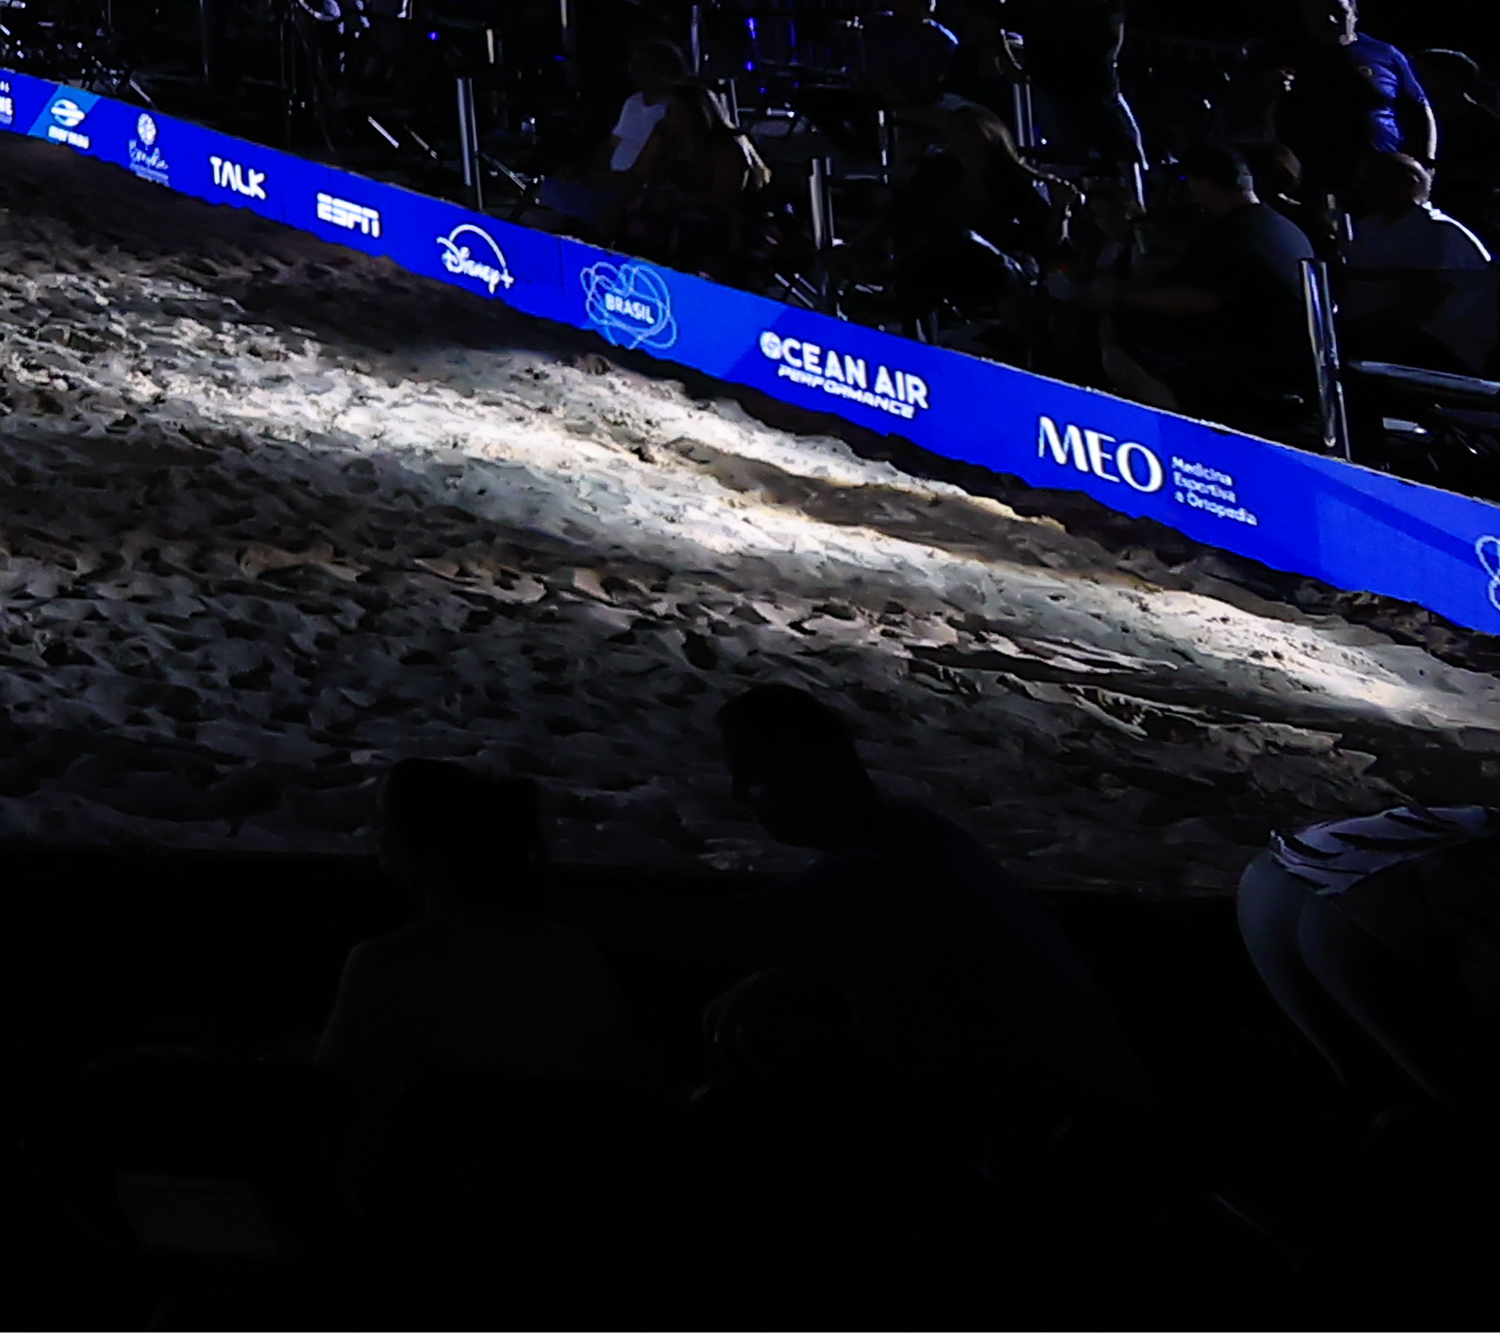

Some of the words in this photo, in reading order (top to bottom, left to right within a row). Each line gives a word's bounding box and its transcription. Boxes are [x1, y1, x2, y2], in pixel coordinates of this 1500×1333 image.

[210, 155, 266, 200] TALK
[316, 192, 381, 238] ESPN
[604, 293, 657, 325] BRASIL
[760, 331, 867, 389] OCEAN
[874, 365, 929, 410] AIR
[778, 364, 916, 420] PERFORMANCE
[1038, 415, 1164, 493] MEO
[1171, 456, 1233, 486] Medicina
[1173, 471, 1237, 504] Esportiva
[1186, 491, 1258, 527] Ortopedia
